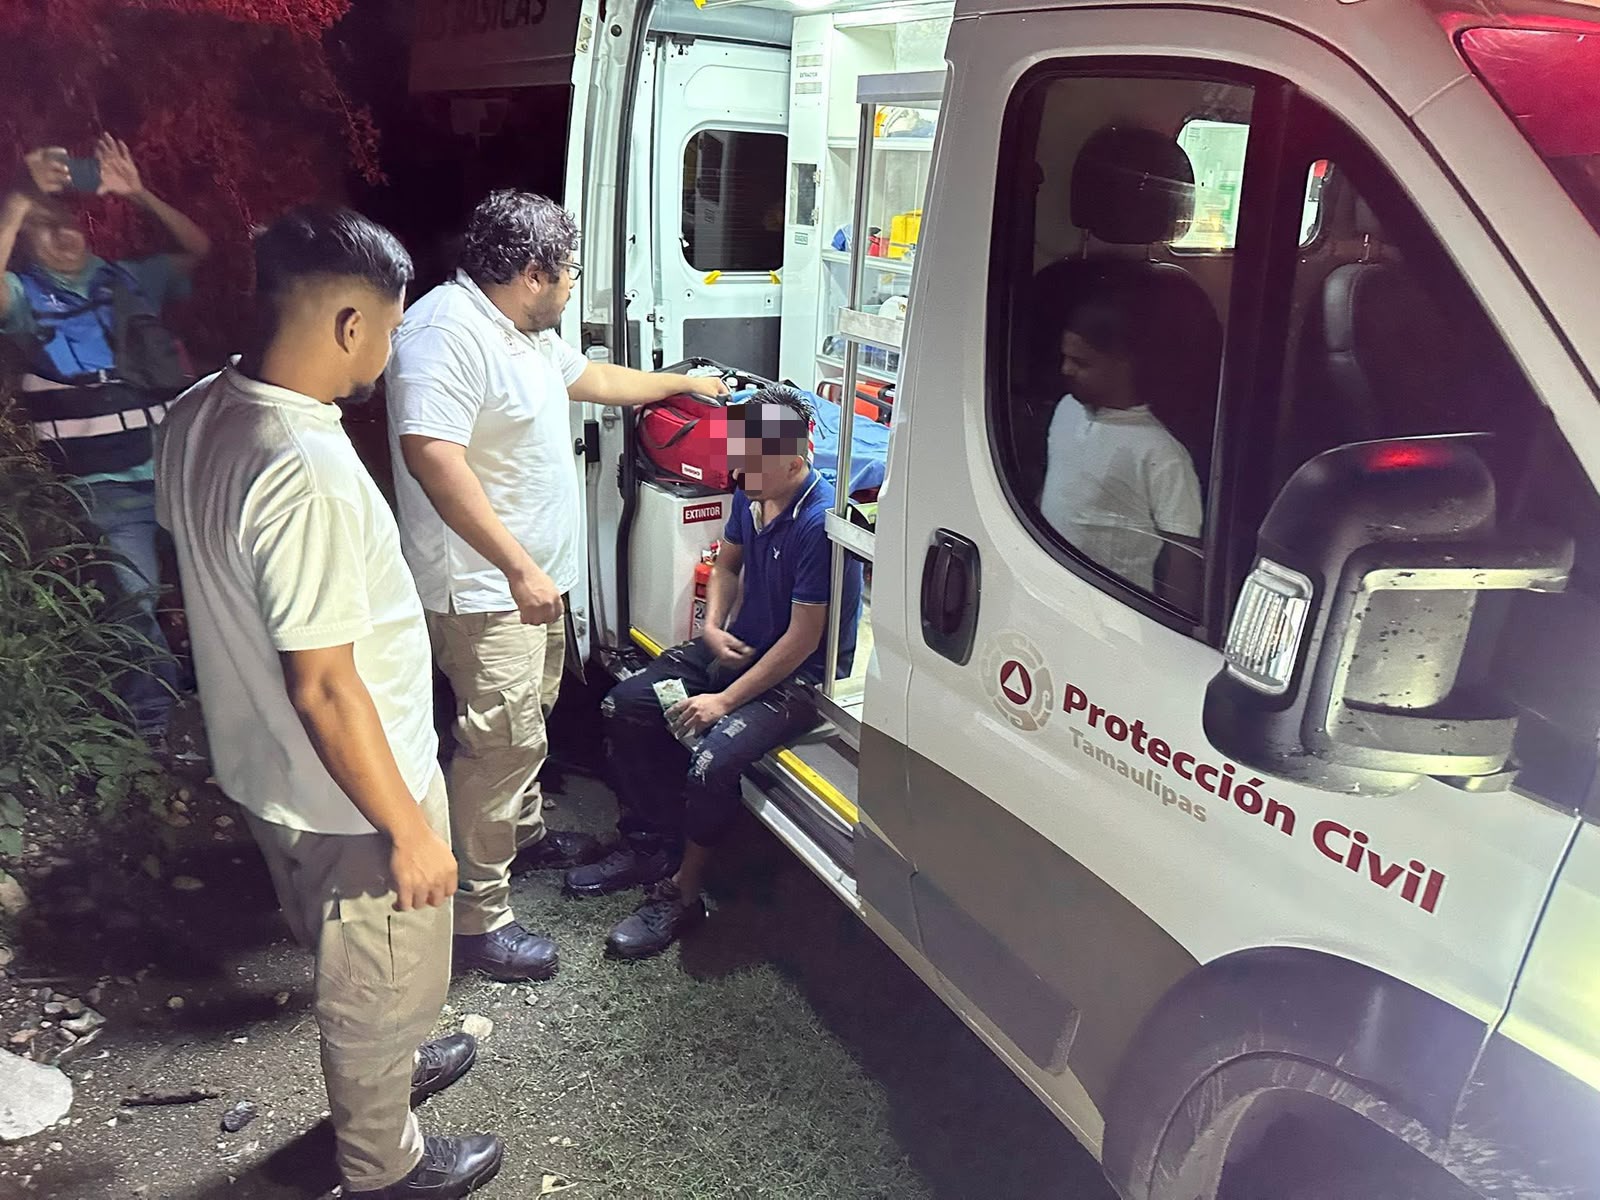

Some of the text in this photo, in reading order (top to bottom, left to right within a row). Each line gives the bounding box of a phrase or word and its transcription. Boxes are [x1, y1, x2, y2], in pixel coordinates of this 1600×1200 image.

[685, 506, 720, 520] EXTINTOR
[1062, 682, 1446, 915] Protección Civil
[1068, 726, 1208, 823] Tamaulipas
